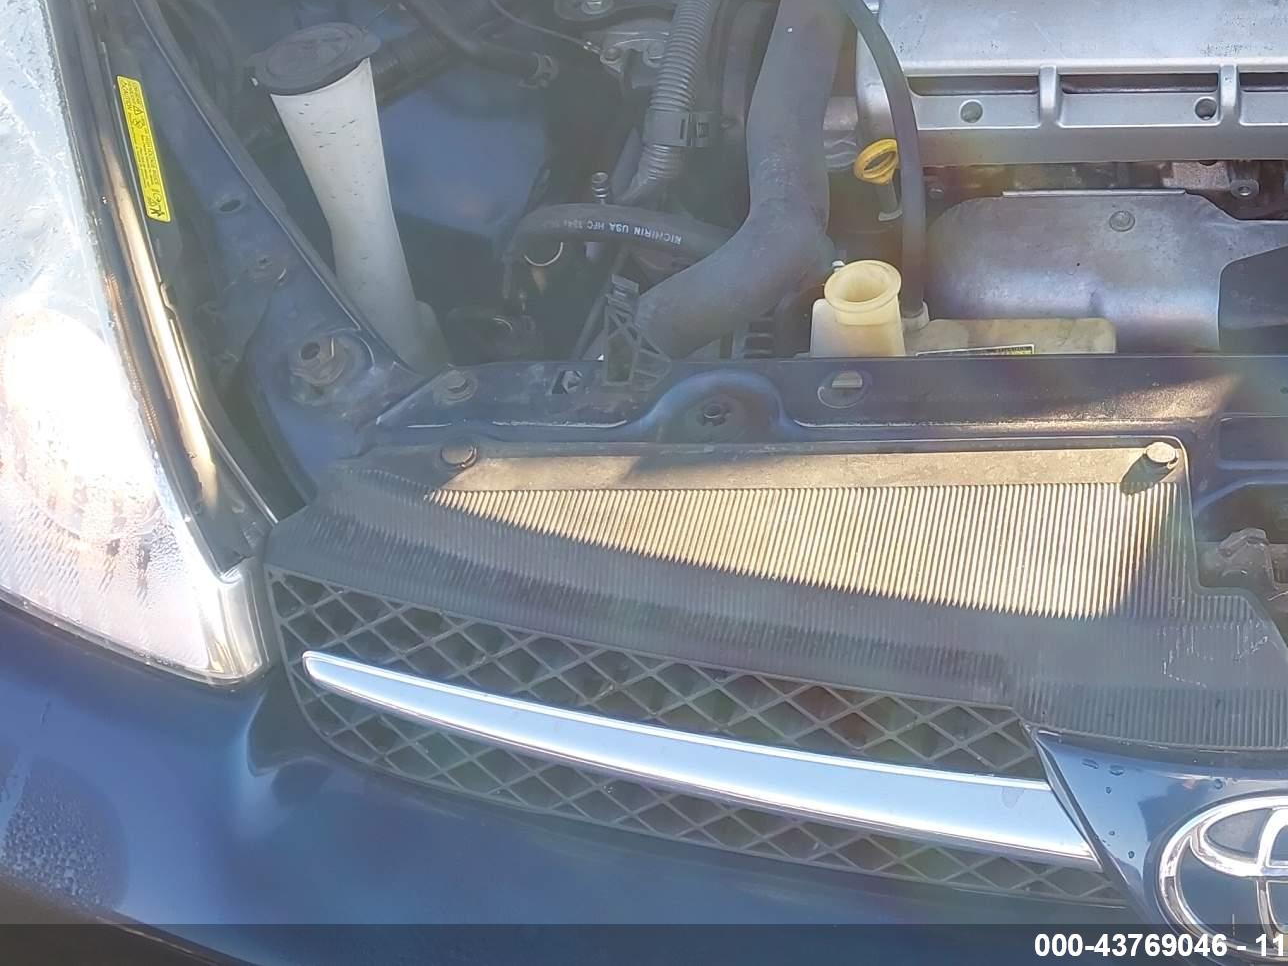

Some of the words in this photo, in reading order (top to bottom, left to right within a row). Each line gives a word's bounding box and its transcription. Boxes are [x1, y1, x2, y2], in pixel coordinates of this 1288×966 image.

[587, 220, 605, 230] HFC
[609, 222, 629, 234] USA
[633, 226, 682, 245] NICHIRIN
